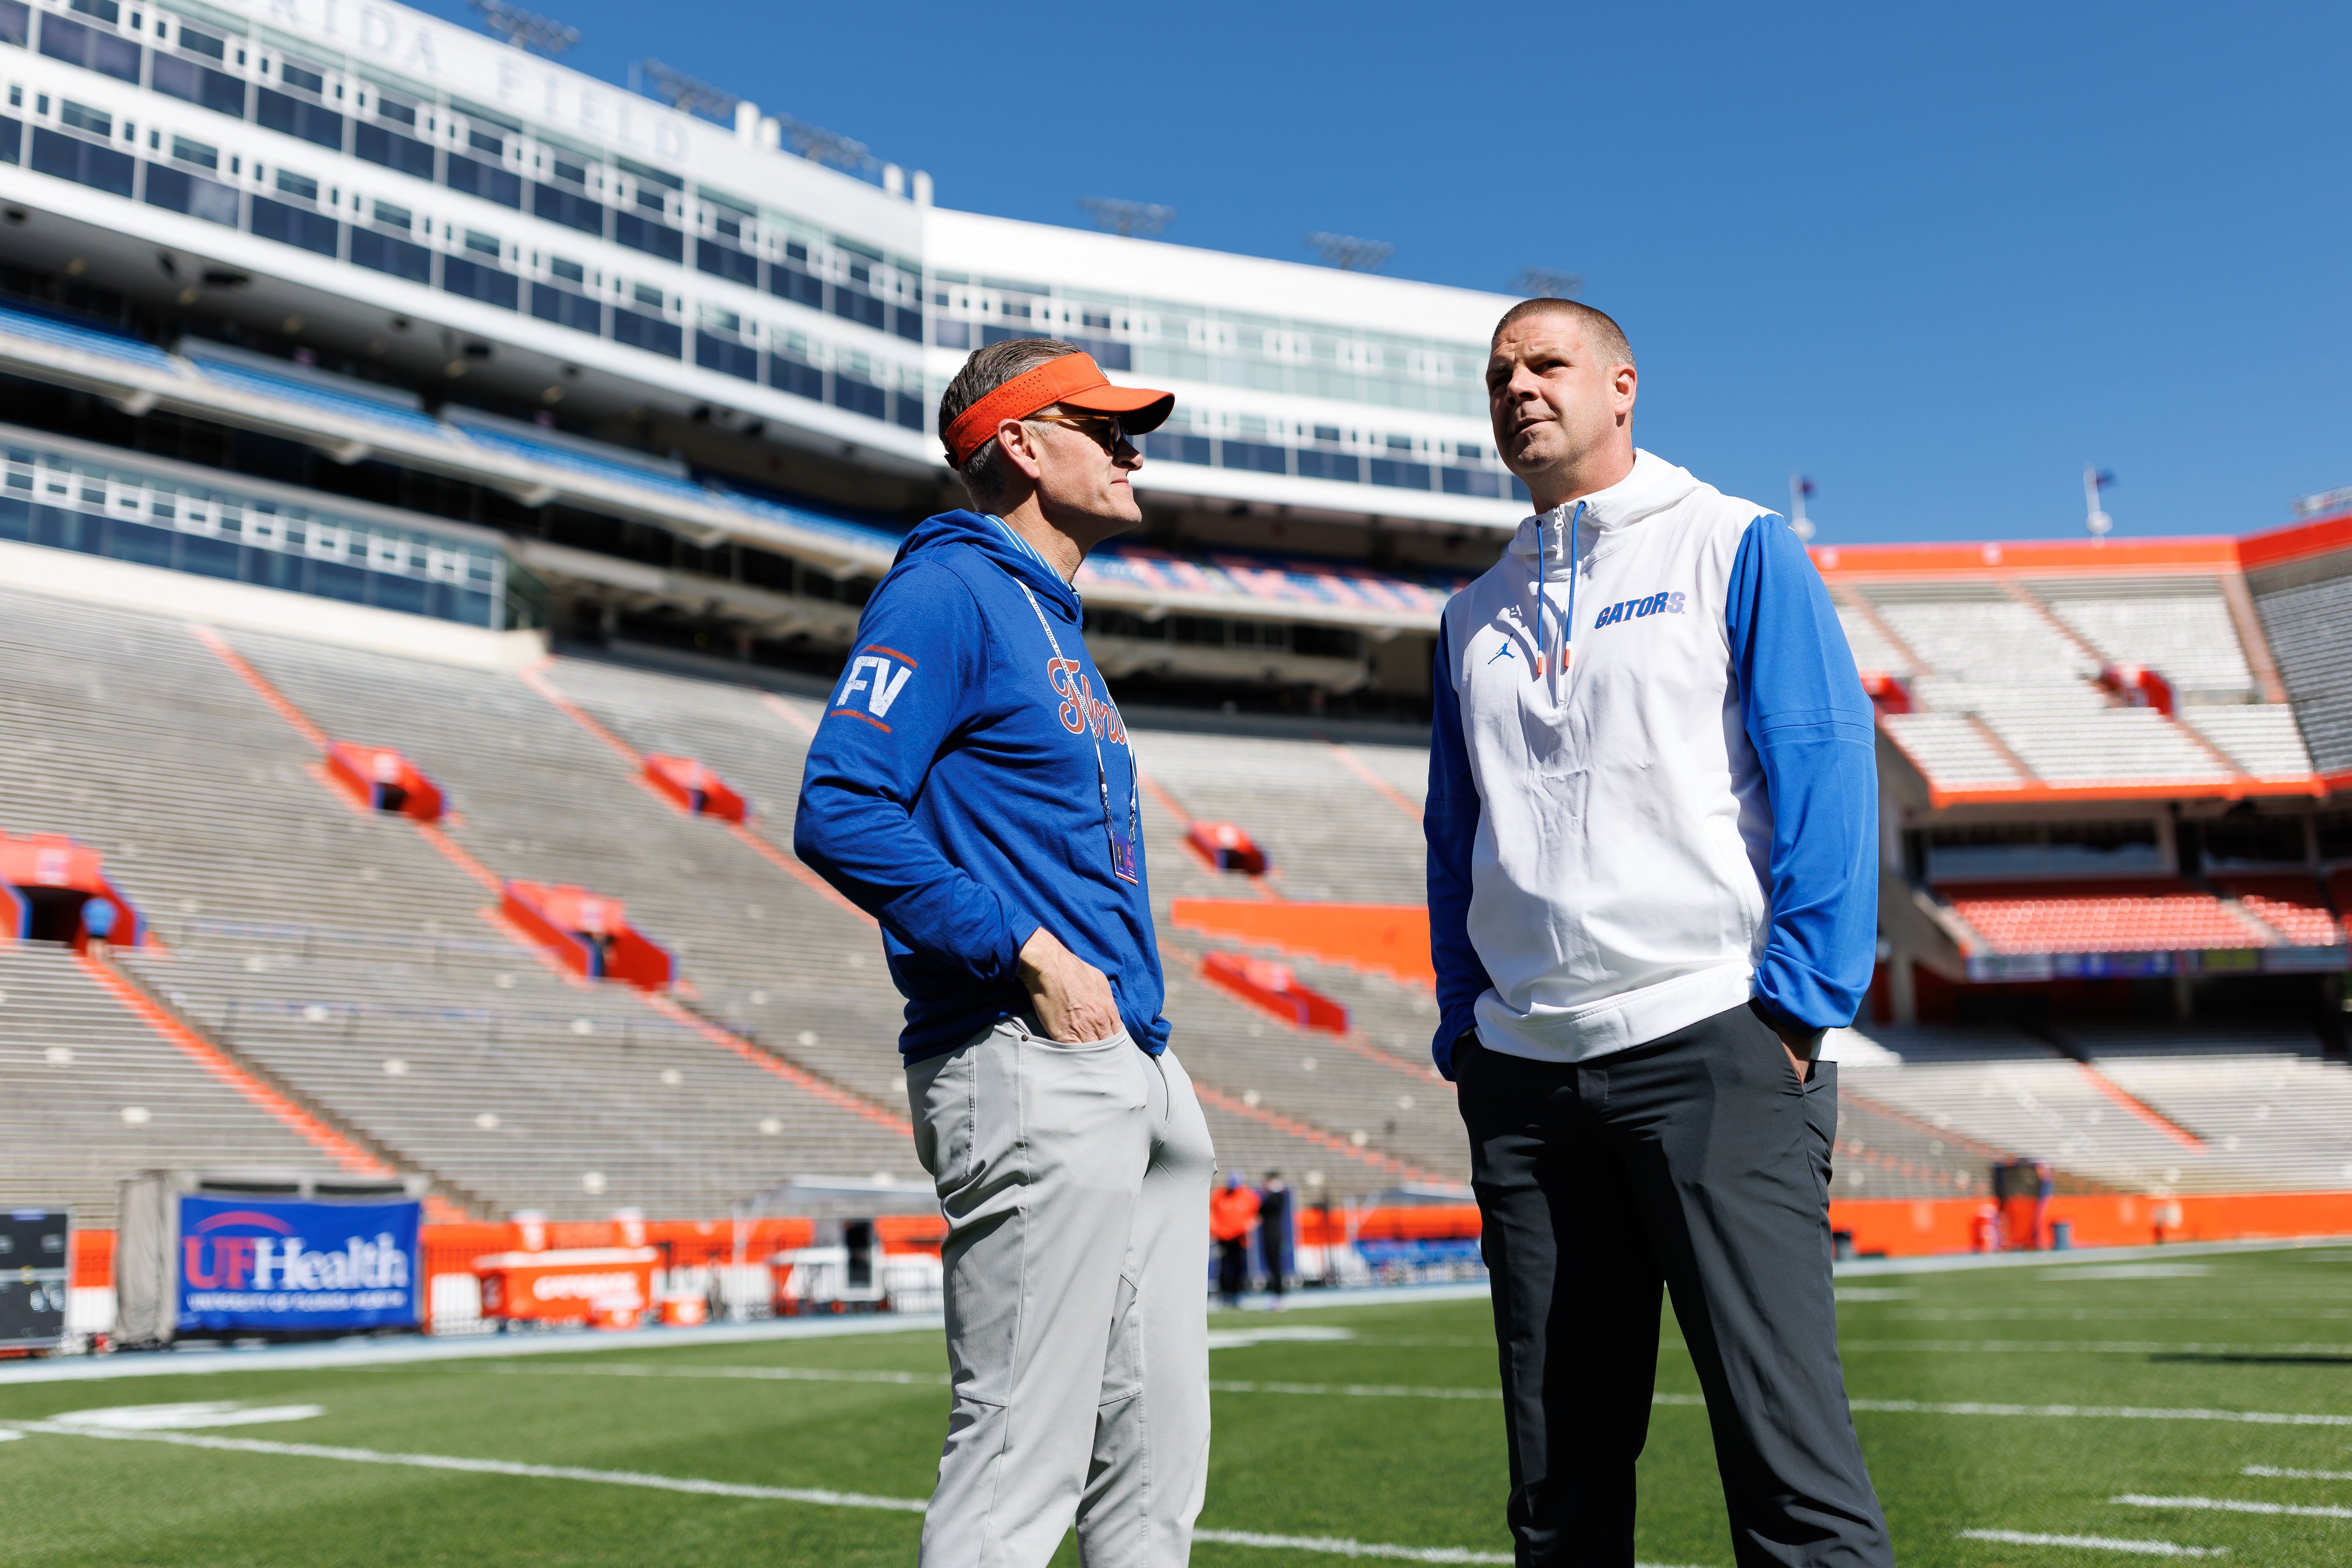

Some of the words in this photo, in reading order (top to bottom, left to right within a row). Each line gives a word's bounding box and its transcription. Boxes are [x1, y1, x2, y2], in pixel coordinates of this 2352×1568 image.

[495, 57, 692, 163] FIELD
[1031, 601, 1049, 629] INTEGRITY
[1594, 591, 1686, 630] GATORS
[1047, 631, 1056, 645] WITH
[1054, 647, 1072, 680] EXPERIENCE
[836, 655, 913, 718] FV
[1070, 681, 1092, 724] HAMPIONSHIP
